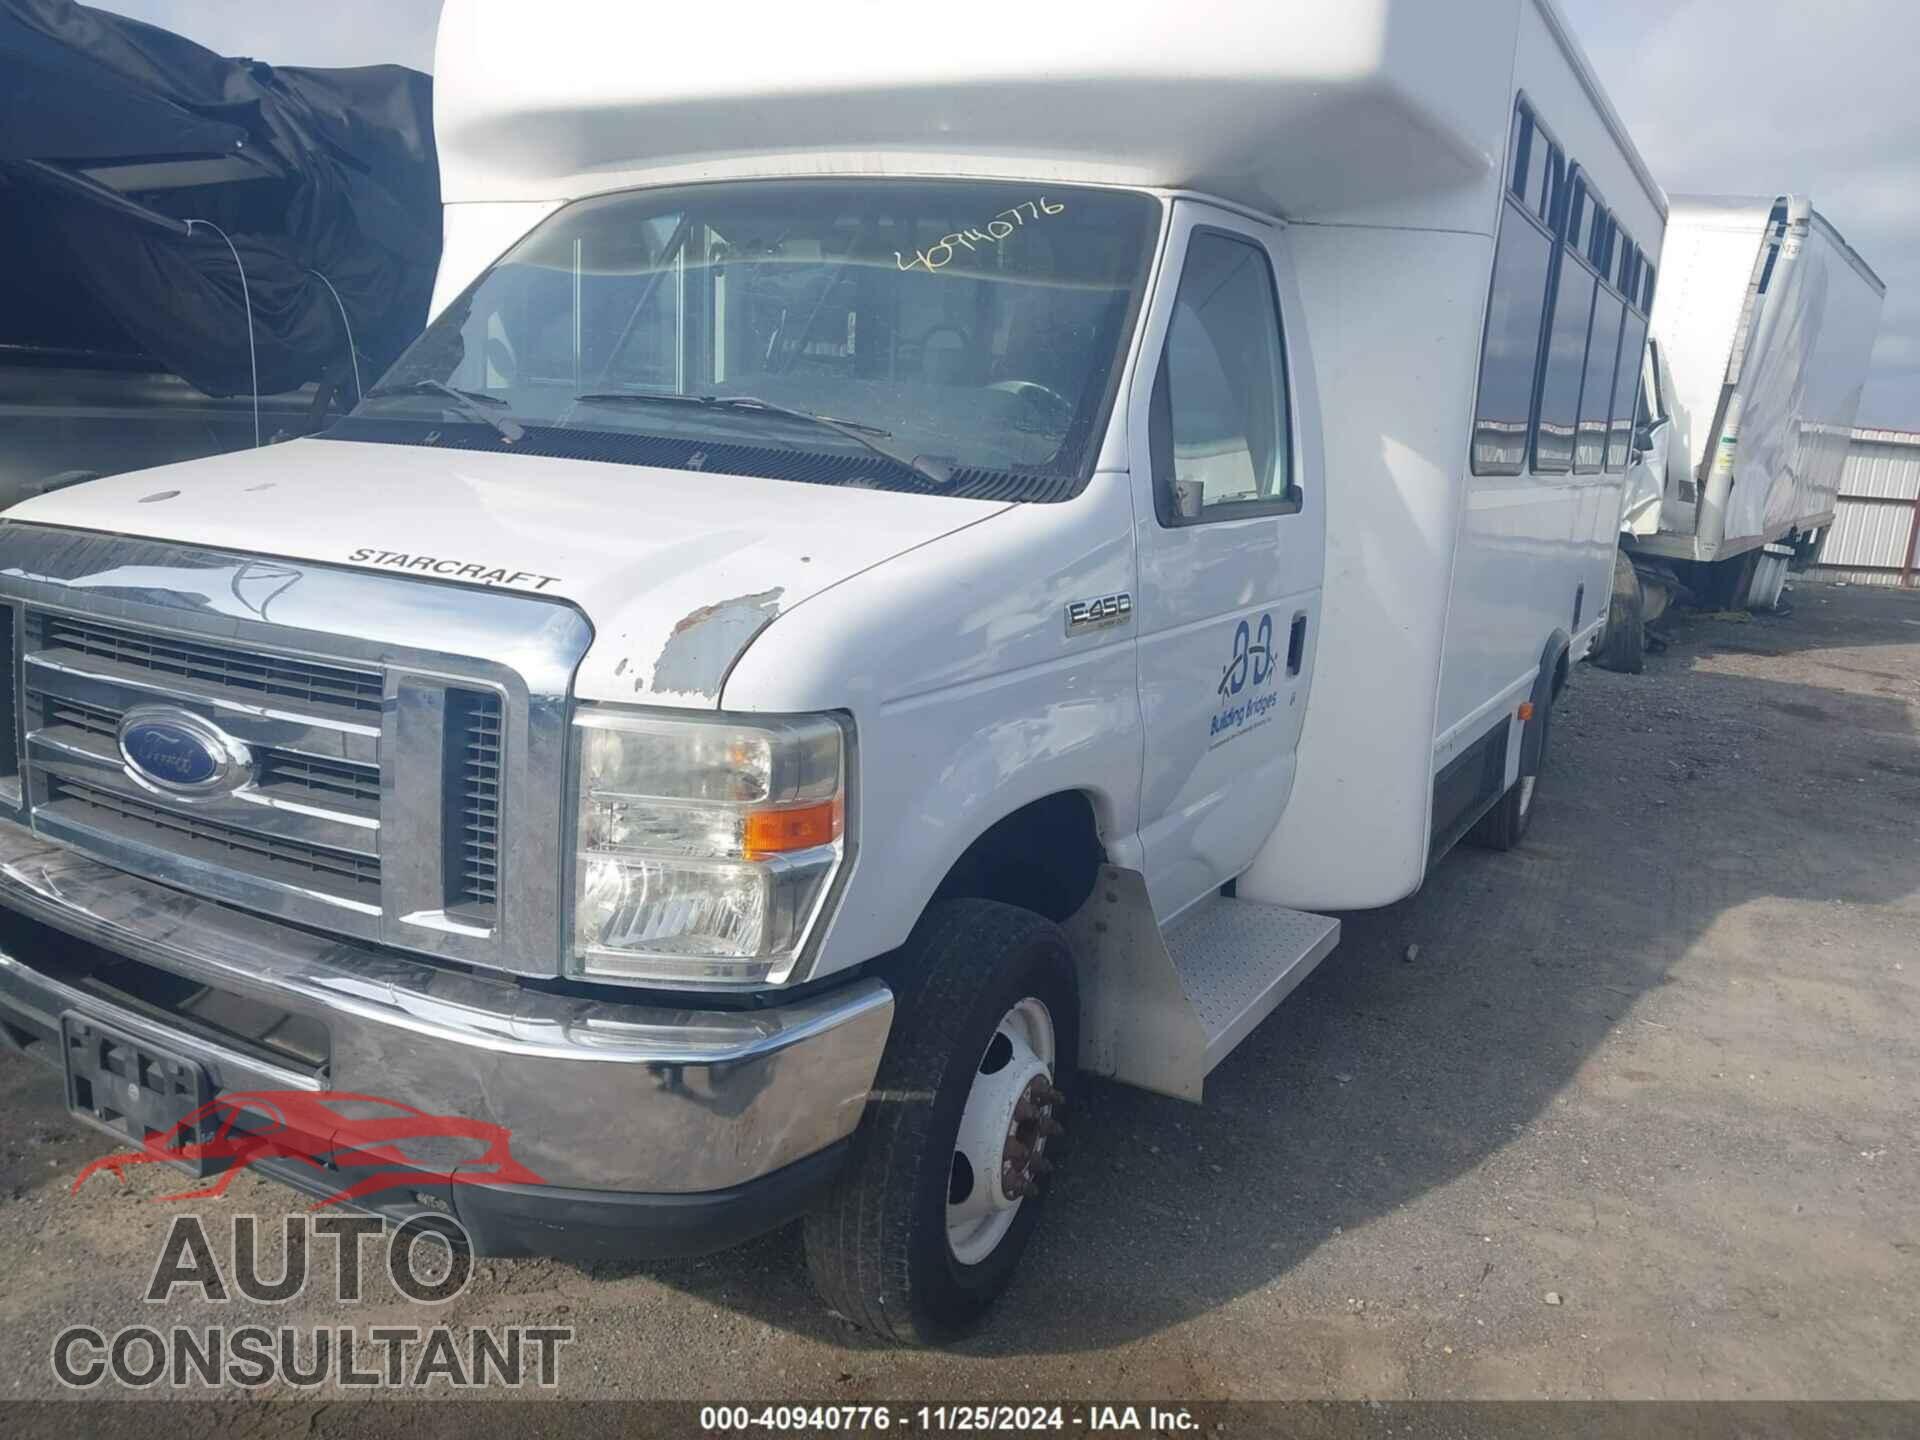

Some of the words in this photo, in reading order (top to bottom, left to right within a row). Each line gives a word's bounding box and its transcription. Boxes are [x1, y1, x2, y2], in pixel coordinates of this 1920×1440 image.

[894, 196, 1065, 273] 40940776
[348, 548, 562, 590] STARCRAFT
[1210, 706, 1245, 737] Building
[1245, 691, 1278, 719] Bridges
